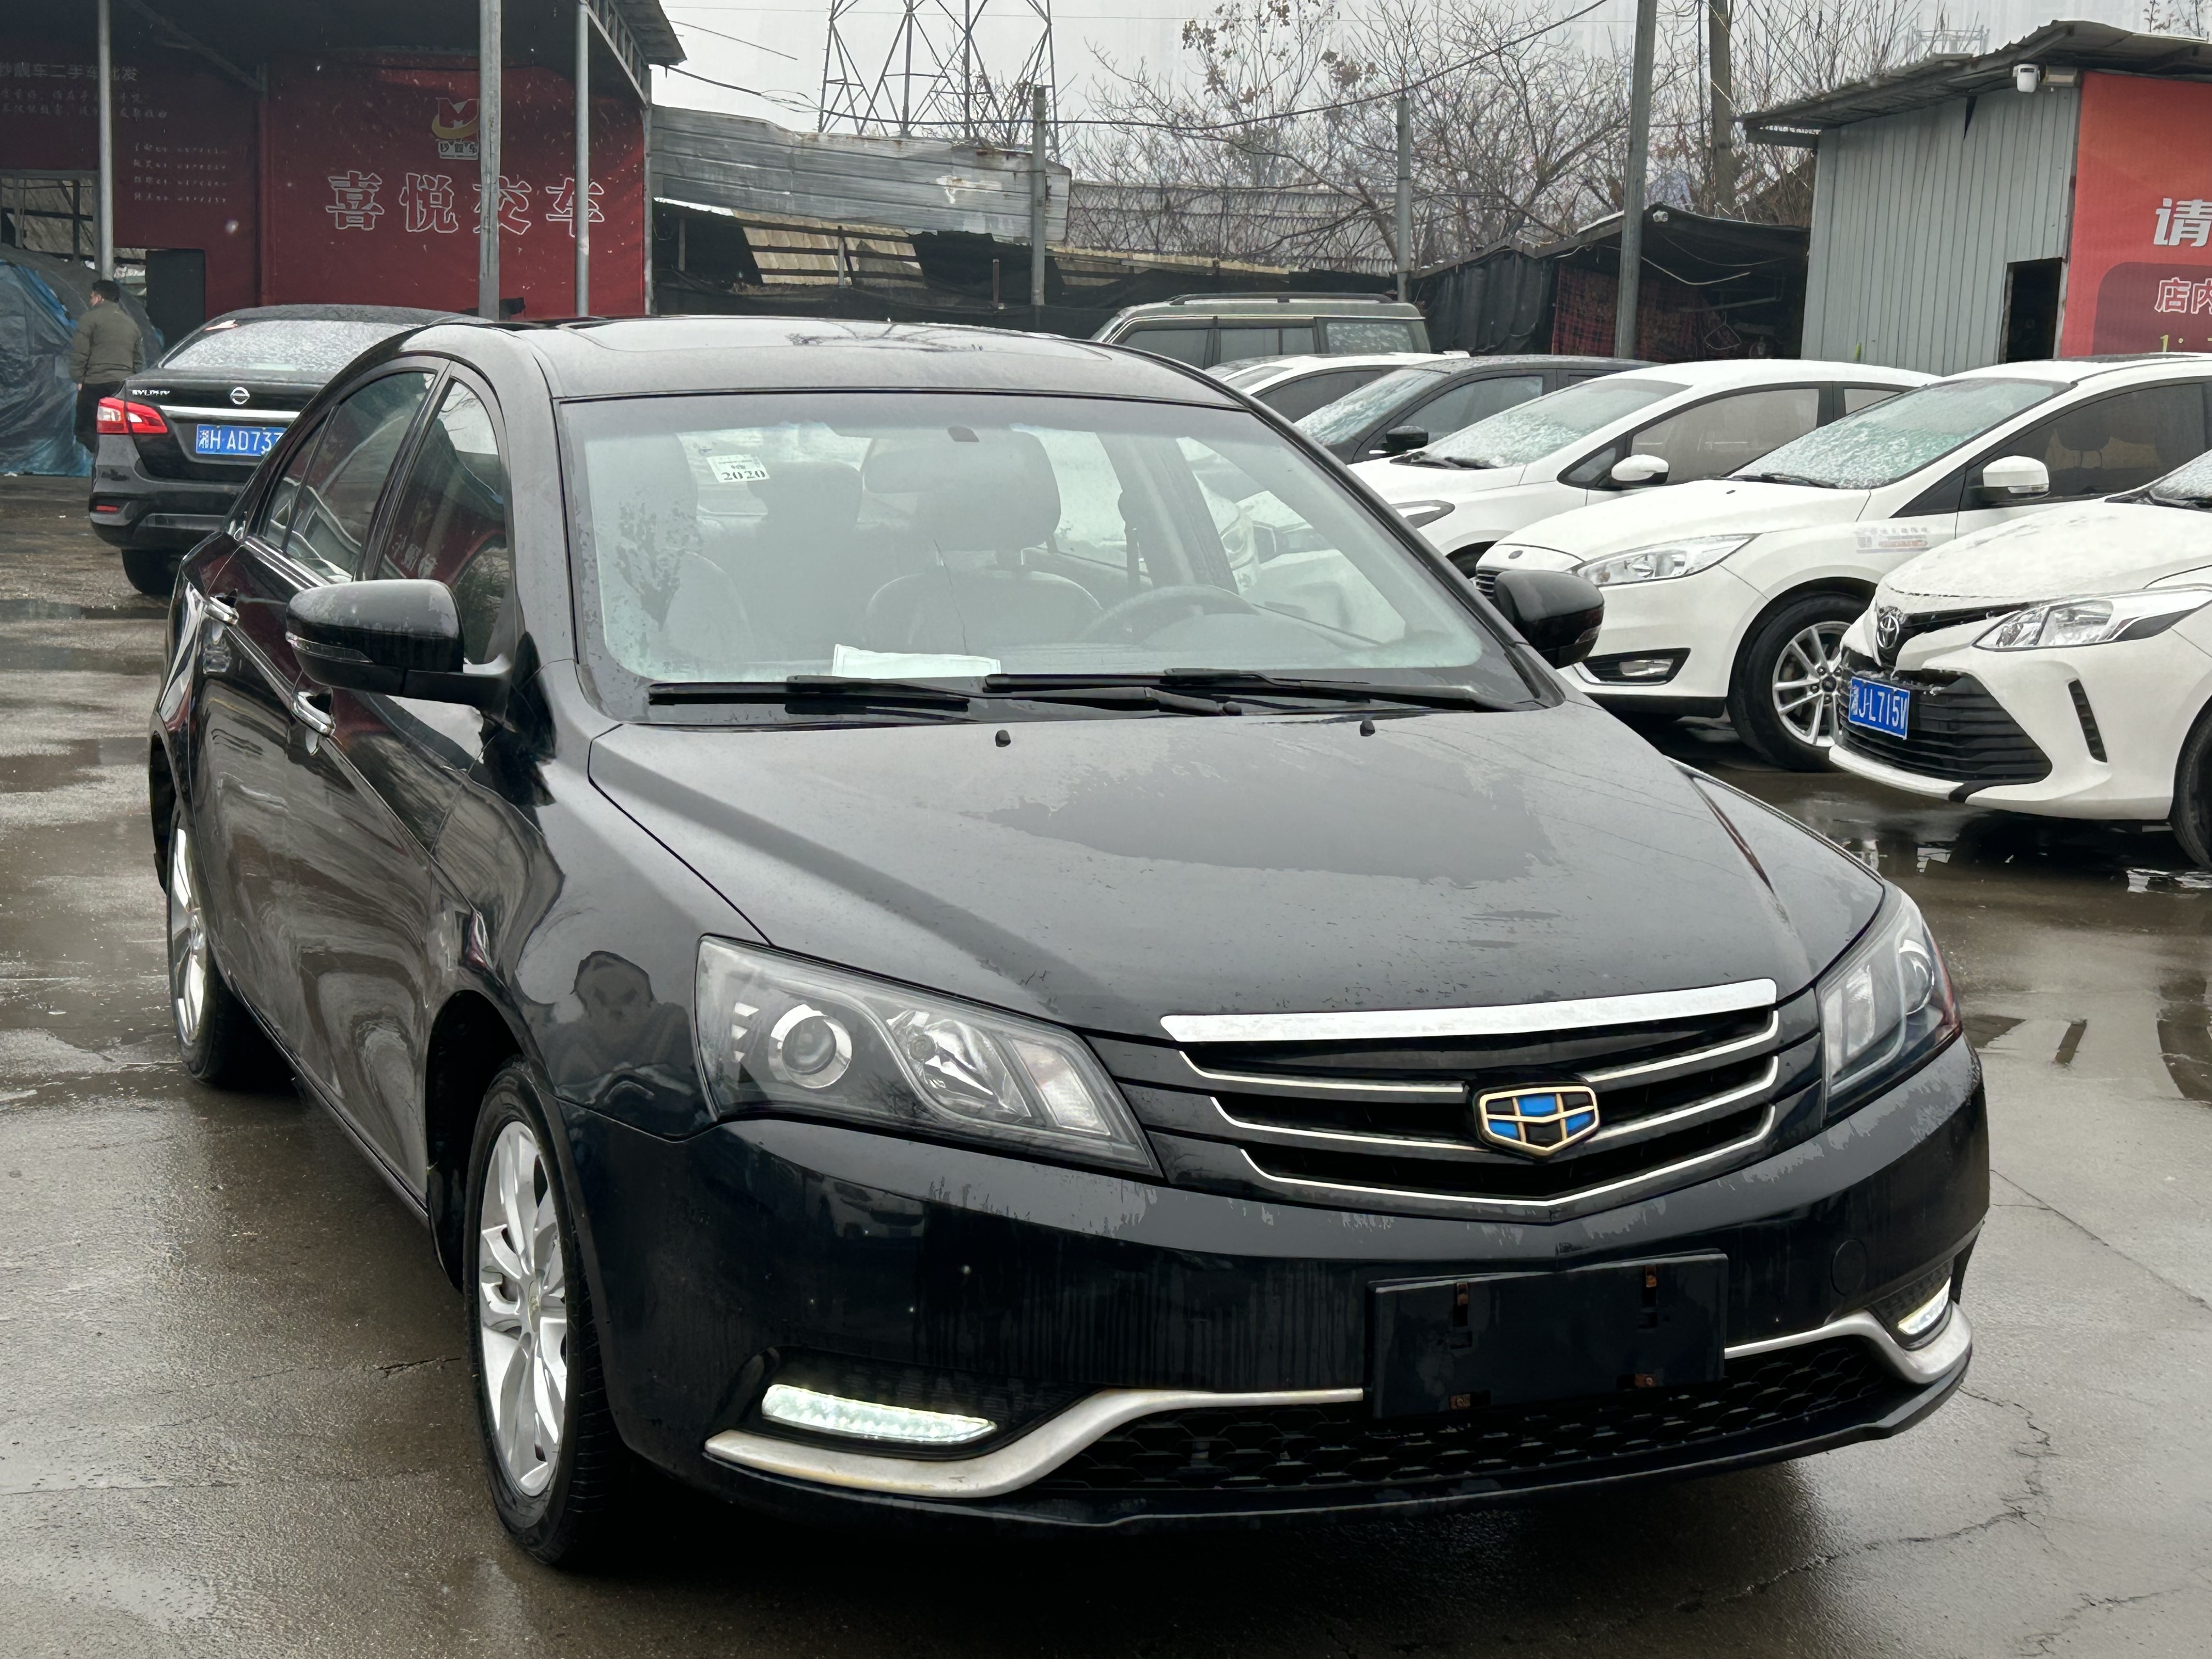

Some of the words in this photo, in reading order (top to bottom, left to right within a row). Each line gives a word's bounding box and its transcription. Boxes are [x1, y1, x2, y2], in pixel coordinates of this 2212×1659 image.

[326, 171, 605, 237] 喜悦交车
[2153, 198, 2212, 247] 请
[721, 470, 766, 481] 2020
